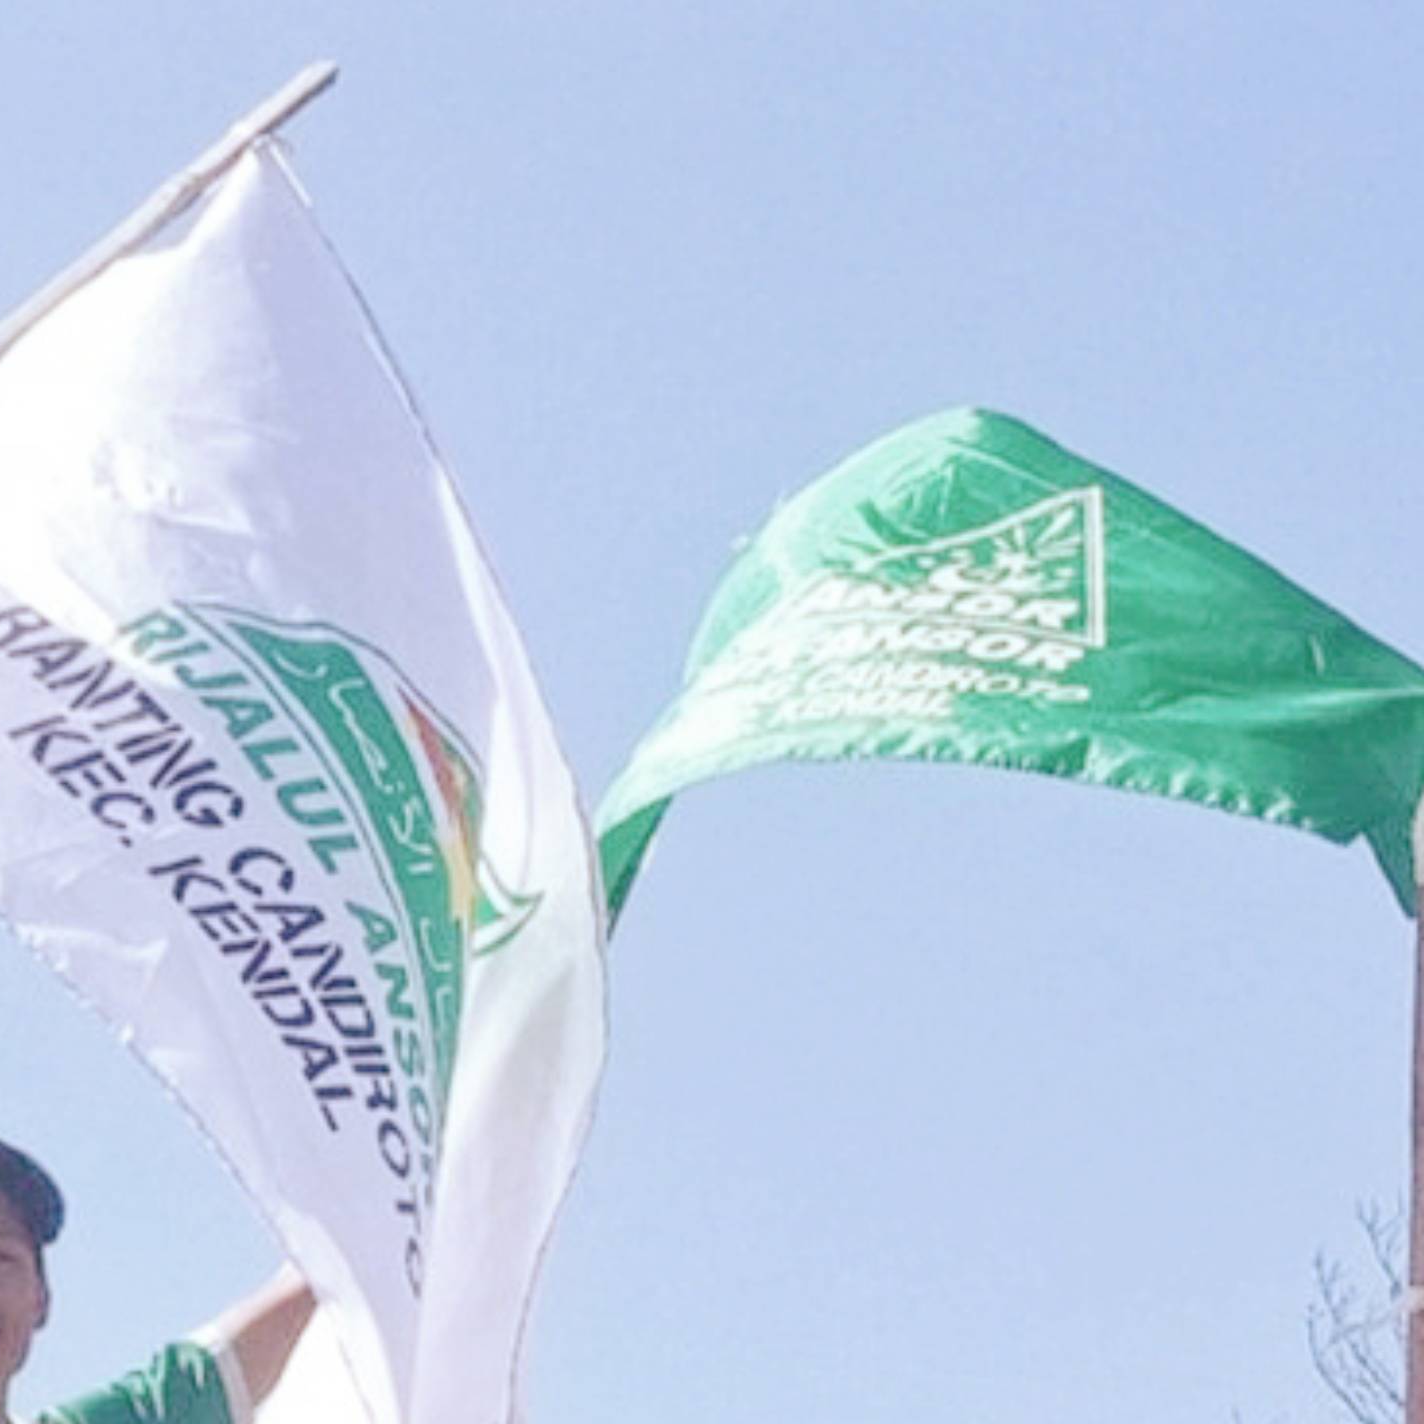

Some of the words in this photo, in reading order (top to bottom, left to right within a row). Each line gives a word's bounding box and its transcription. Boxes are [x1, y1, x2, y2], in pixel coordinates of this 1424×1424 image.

[8, 712, 156, 848] KEC.
[148, 855, 355, 1133] KENDAL
[116, 609, 359, 875] RIJALUL
[228, 846, 424, 1300] CANDIROTO
